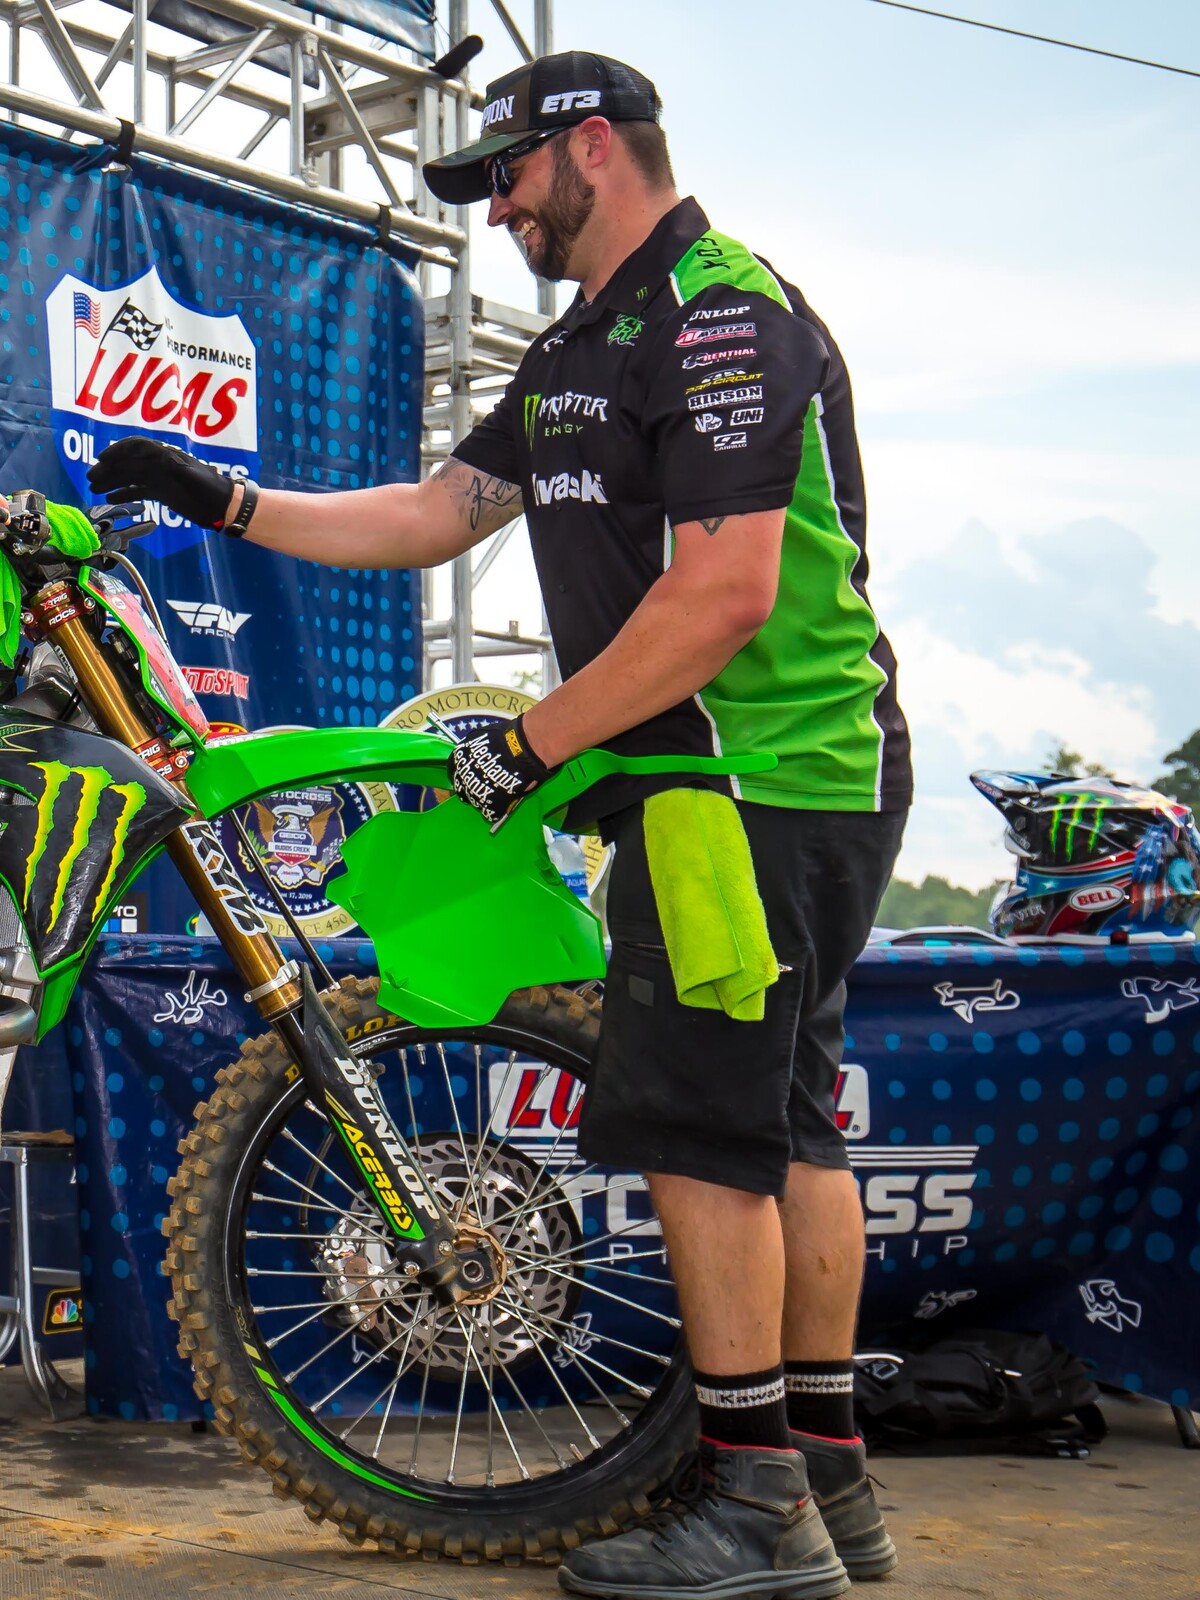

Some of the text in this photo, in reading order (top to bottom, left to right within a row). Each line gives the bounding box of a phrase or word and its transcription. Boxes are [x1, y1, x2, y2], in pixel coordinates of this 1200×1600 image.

[480, 95, 515, 134] PION
[539, 89, 602, 115] ET3
[166, 335, 253, 371] PERFORMANCE
[74, 347, 248, 438] LUCAS
[688, 386, 762, 408] HINSON
[732, 409, 762, 424] UNI
[62, 428, 99, 466] OIL
[166, 599, 253, 635] FLY
[396, 691, 534, 729] RO MOTOCRO
[1076, 889, 1118, 907] BELL
[277, 921, 323, 937] PLCE
[325, 912, 348, 931] 450
[333, 1055, 441, 1221] DUNLOP
[341, 1121, 414, 1231] ACERBIS
